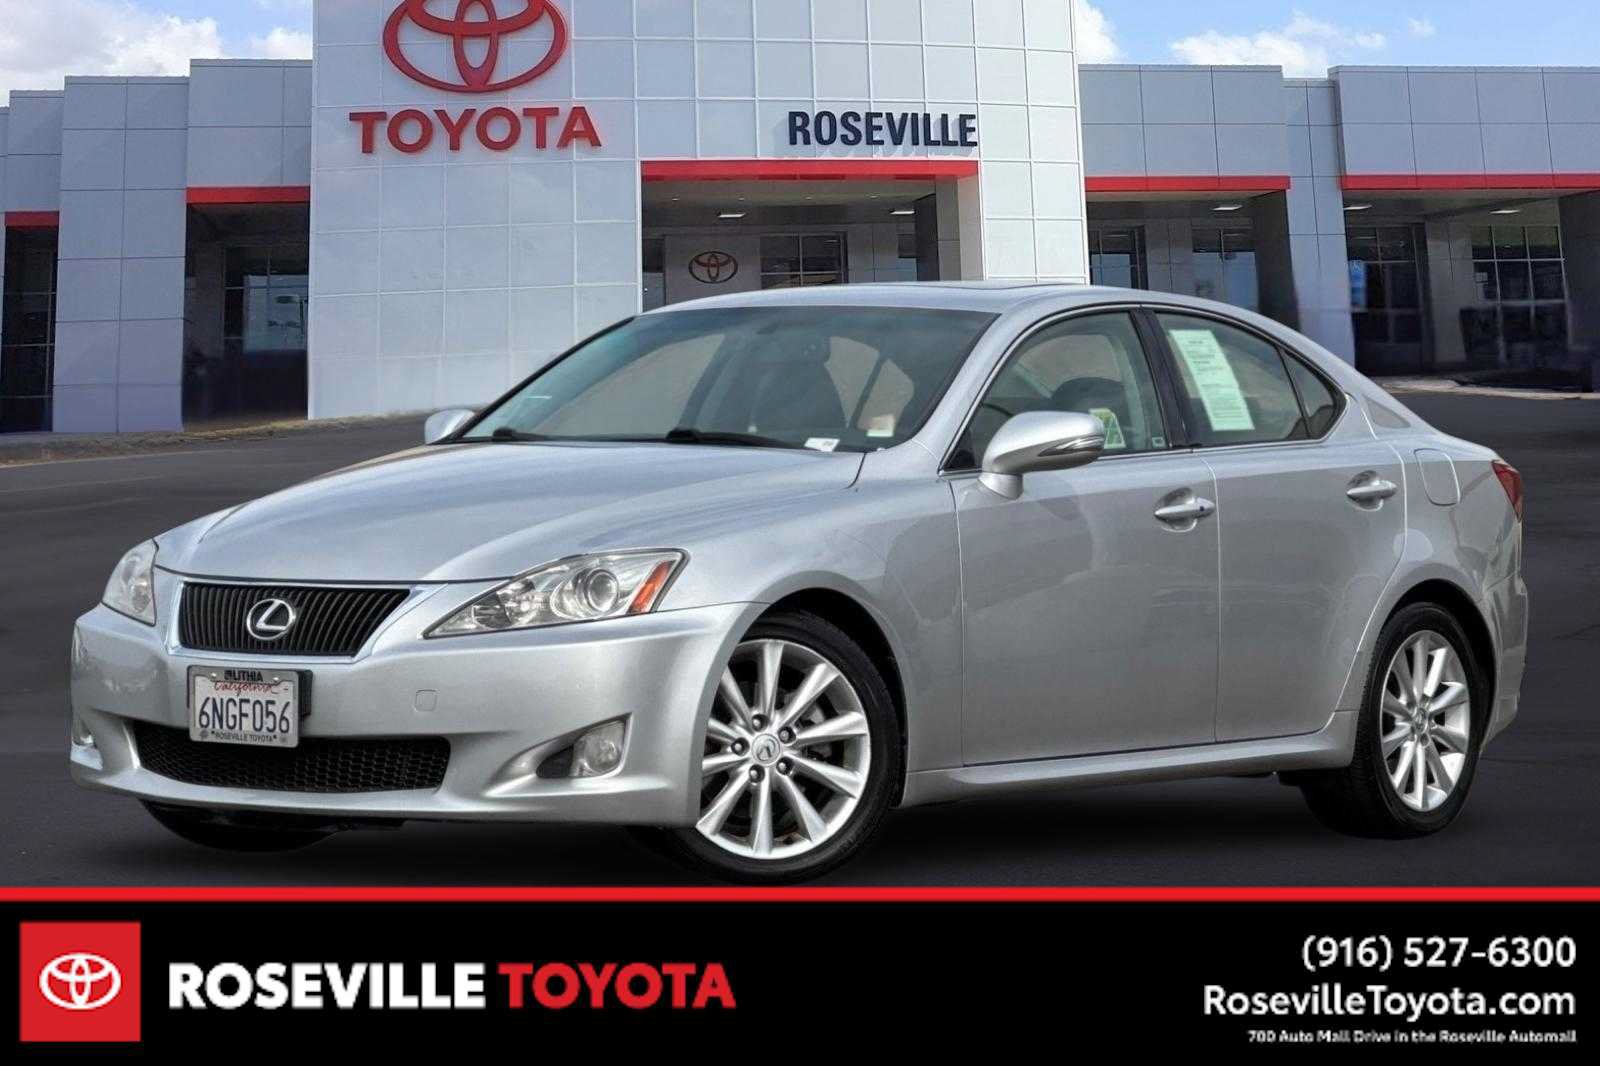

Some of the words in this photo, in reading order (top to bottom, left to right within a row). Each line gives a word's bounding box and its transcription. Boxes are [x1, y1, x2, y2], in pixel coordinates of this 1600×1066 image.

[349, 106, 603, 153] TOYOTA
[788, 110, 978, 148] ROSEVILLE
[214, 680, 273, 697] California
[233, 670, 264, 682] LITHIA
[198, 696, 291, 734] 6NGF056
